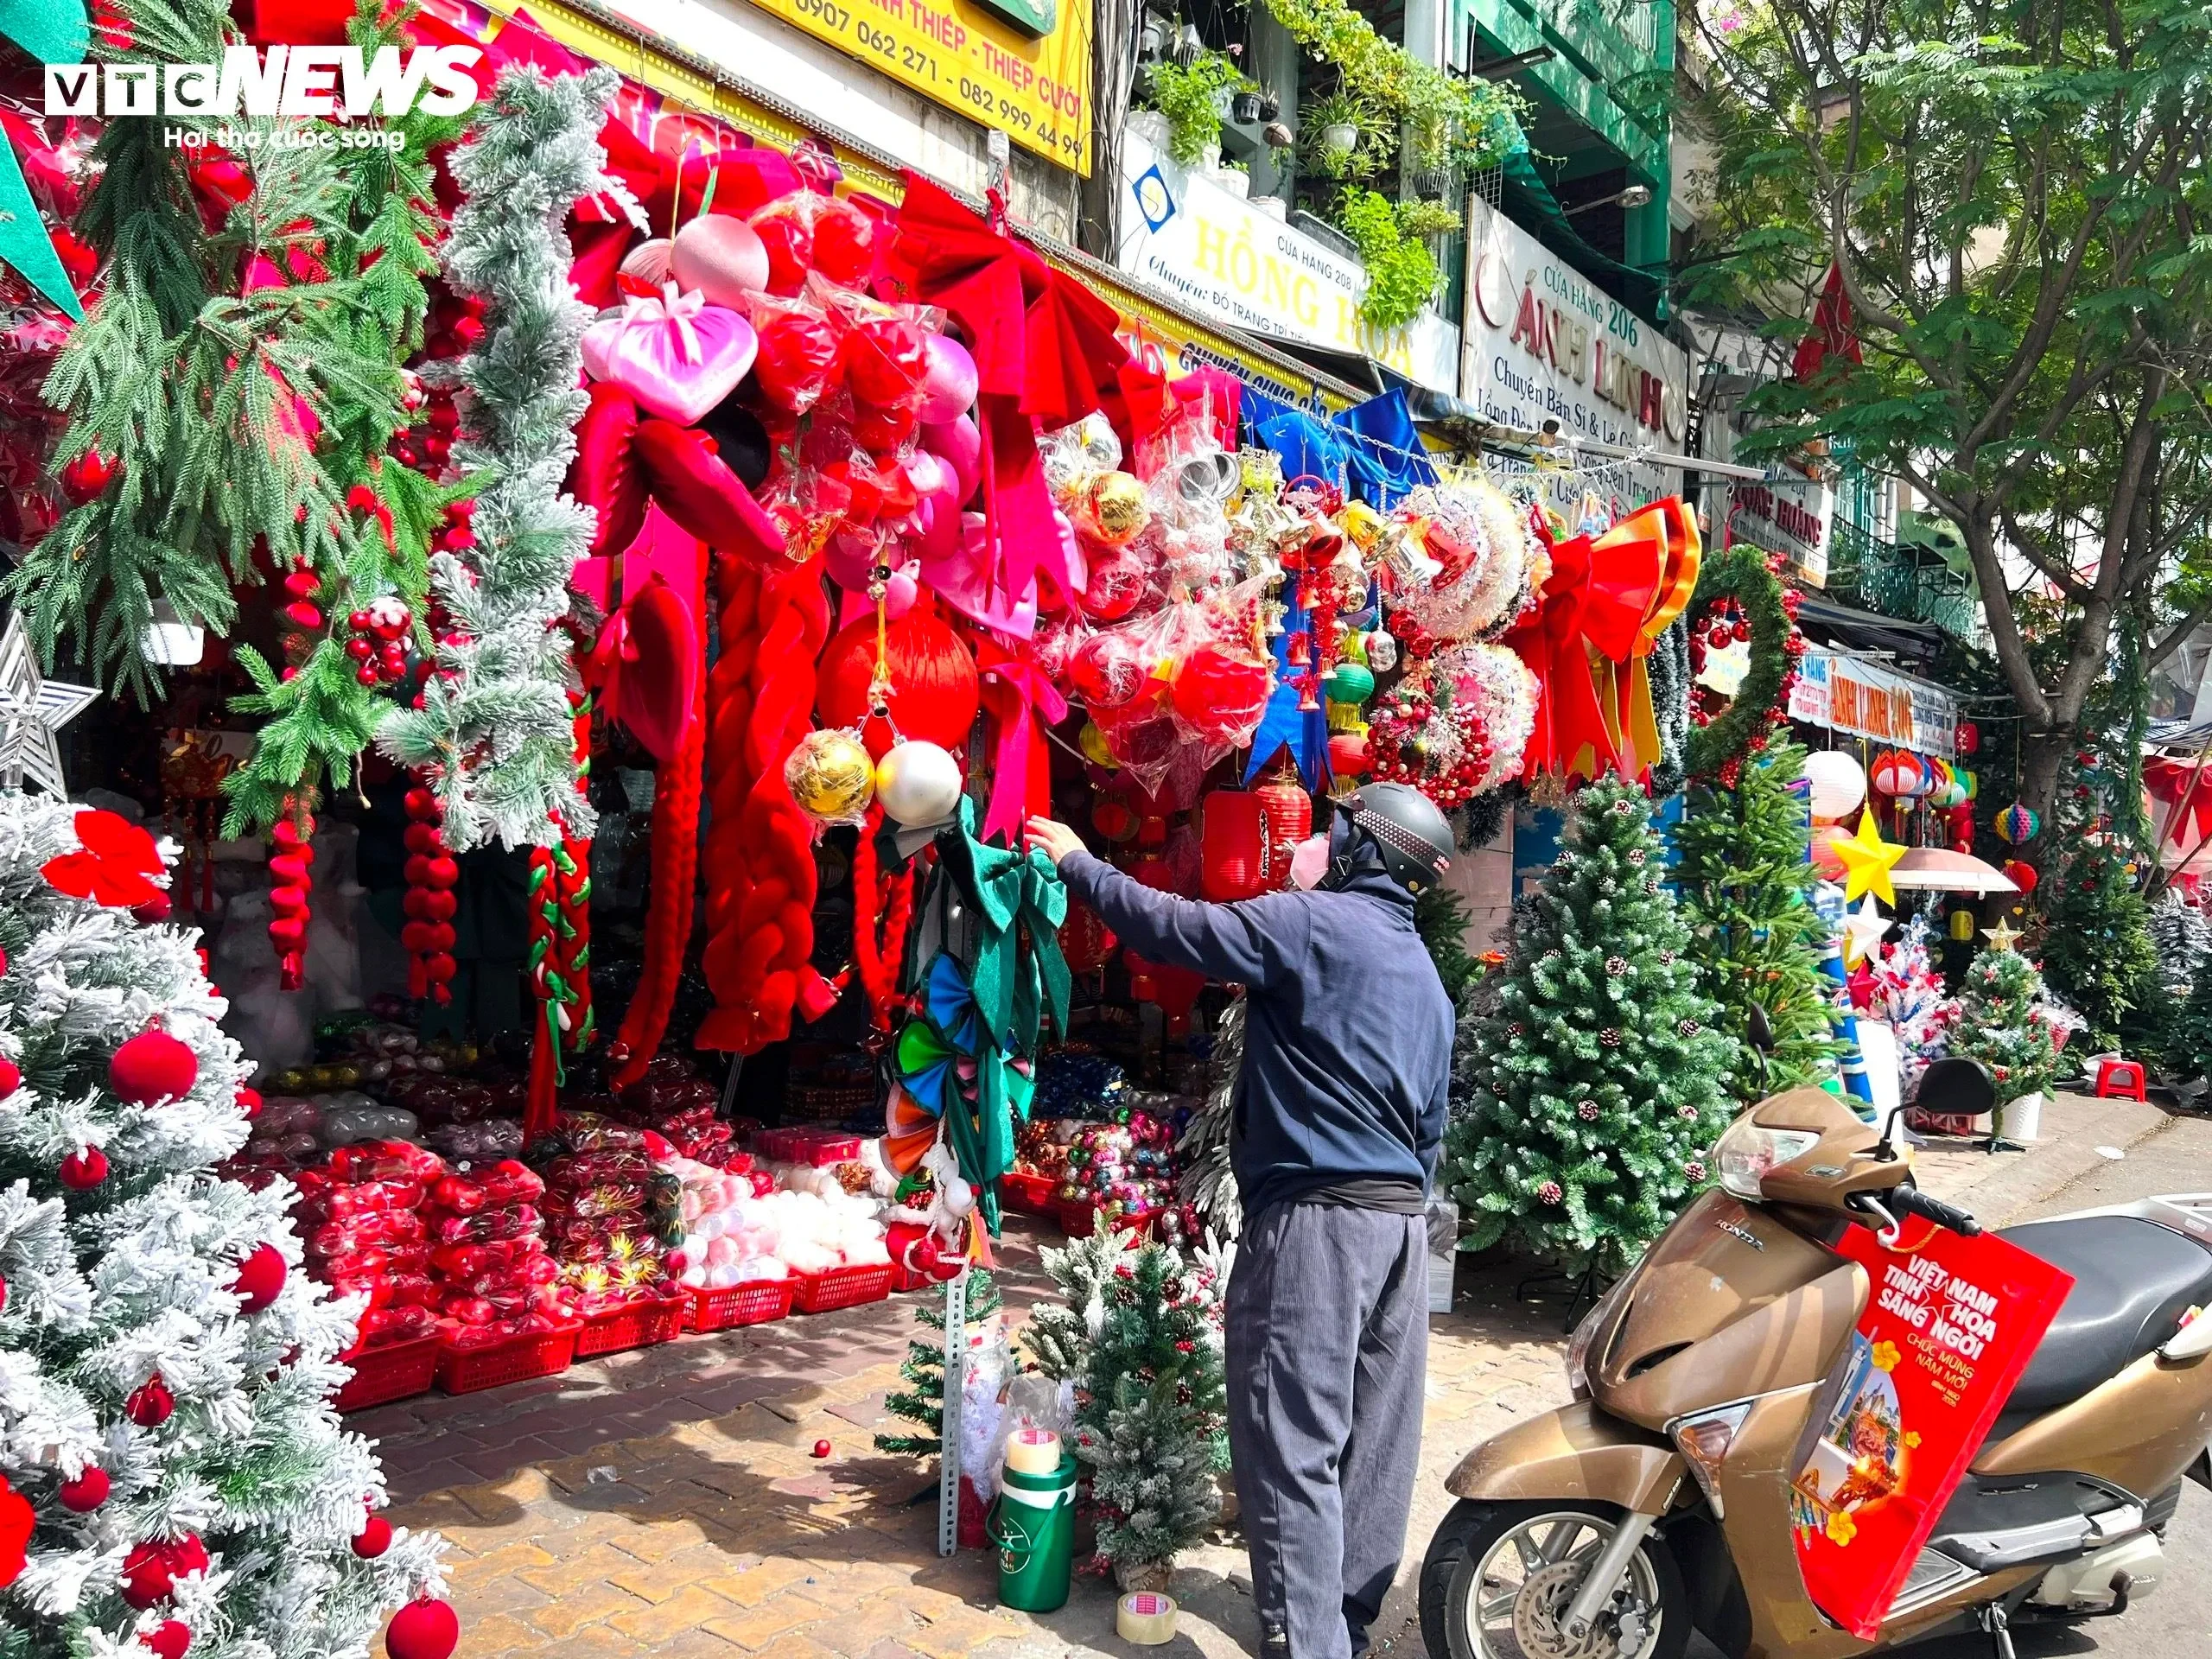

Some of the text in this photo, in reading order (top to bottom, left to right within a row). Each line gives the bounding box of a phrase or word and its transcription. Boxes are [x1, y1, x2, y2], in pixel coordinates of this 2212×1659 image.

[857, 21, 896, 60] 062
[902, 46, 937, 81] 271
[960, 77, 994, 113] 082
[1000, 99, 1032, 130] 999
[1036, 122, 1058, 147] 44
[1062, 134, 1083, 159] 99
[910, 1, 966, 52] THIẾP
[982, 41, 1034, 92] THIỆP
[1039, 75, 1082, 118] CƯỚ
[1192, 215, 1321, 329] HỒNG
[1335, 270, 1351, 290] 208
[1232, 301, 1270, 331] TRANG
[1572, 284, 1603, 324] HÀNG
[1608, 300, 1638, 347] 206
[1494, 356, 1542, 401] Chuyên
[1548, 386, 1572, 423] Bán
[1589, 411, 1599, 437] &
[1877, 1287, 1929, 1328] SÁNG
[1883, 1263, 1998, 1343] TINH HOA
[1907, 1254, 1999, 1318] VIỆT NAM
[1906, 1332, 1940, 1357] CHÚC
[1915, 1352, 1969, 1391] NĂM MỚI
